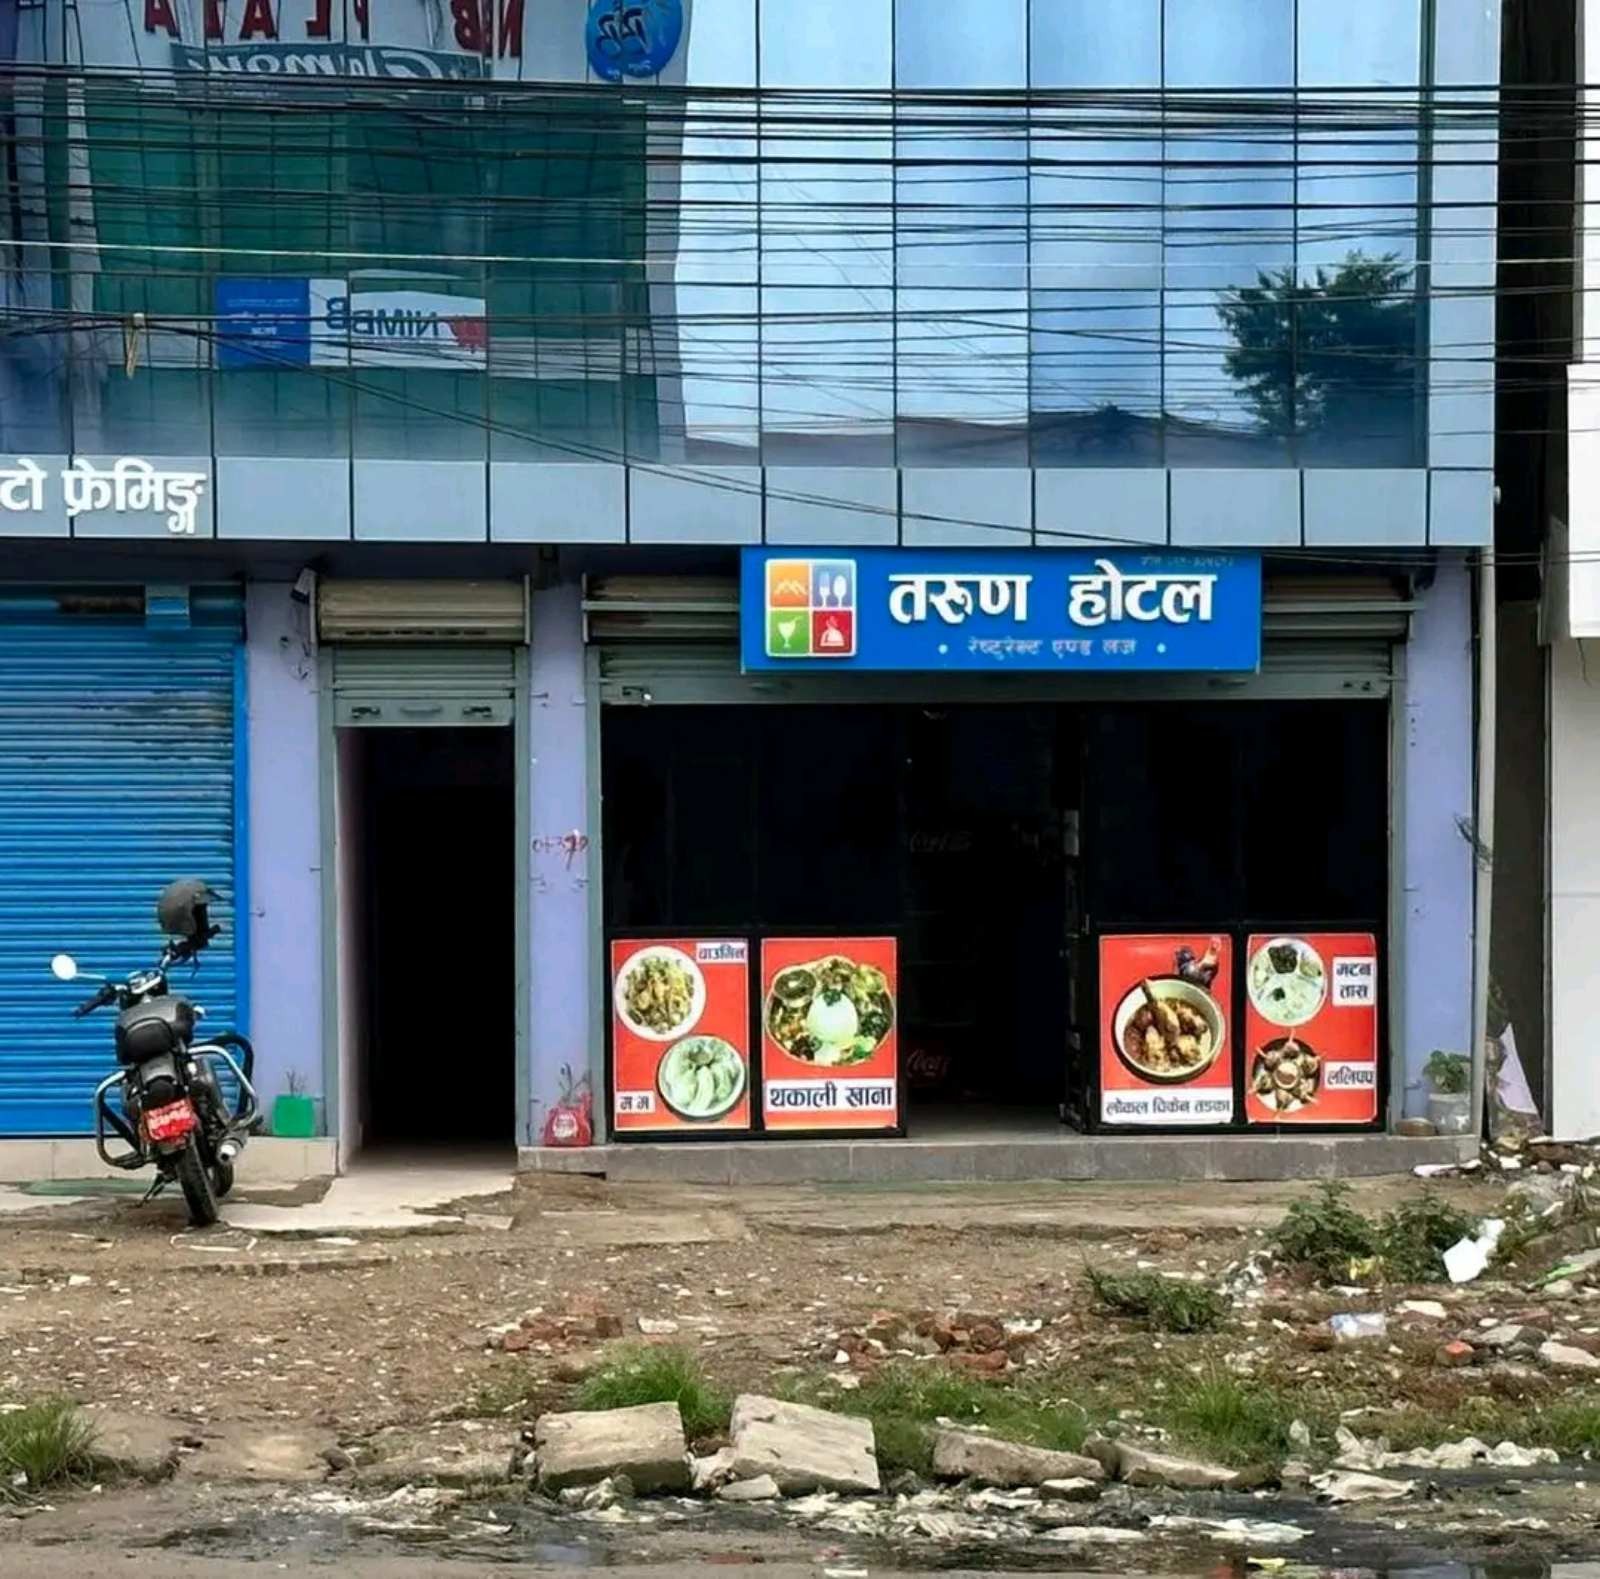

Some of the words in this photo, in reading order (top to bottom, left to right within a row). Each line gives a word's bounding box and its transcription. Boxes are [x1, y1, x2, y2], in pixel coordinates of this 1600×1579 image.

[1068, 558, 1218, 627] होटल
[770, 1080, 837, 1108] थकाली
[845, 1086, 892, 1107] खाना
